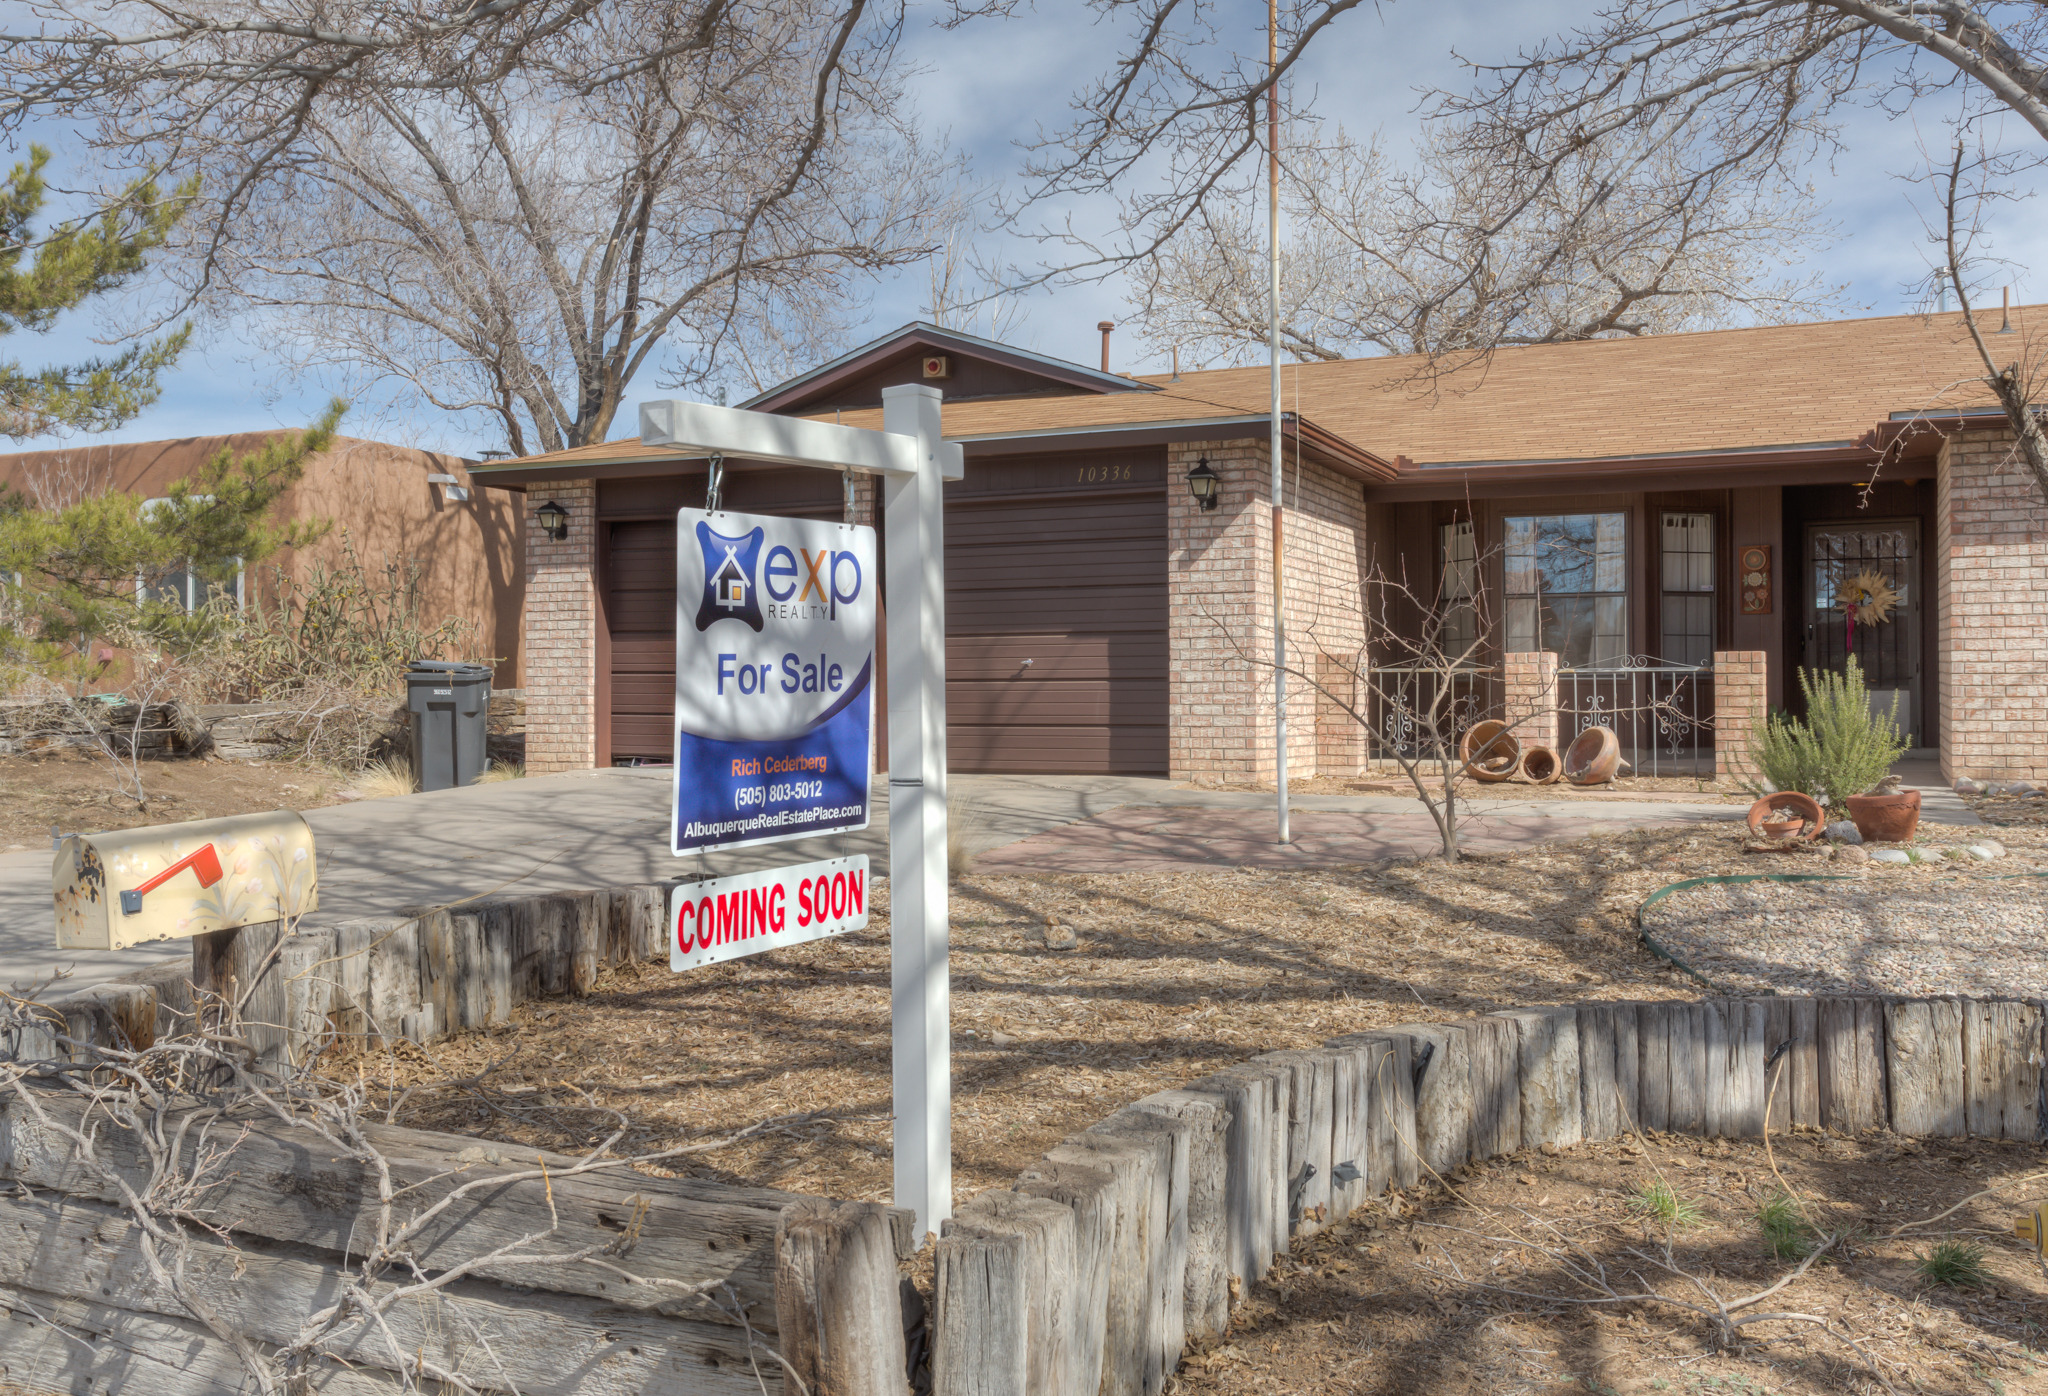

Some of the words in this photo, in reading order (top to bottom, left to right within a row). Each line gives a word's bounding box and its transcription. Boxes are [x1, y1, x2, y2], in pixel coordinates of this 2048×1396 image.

[1077, 465, 1131, 482] 10336
[764, 545, 862, 620] exp
[768, 604, 828, 619] REALTY
[717, 653, 772, 695] For
[781, 652, 843, 694] Sale
[731, 758, 761, 777] Rich
[764, 754, 827, 773] Cederberg
[735, 785, 766, 810] (505)
[769, 780, 822, 802] 803-5012
[684, 804, 862, 838] AlbuquerqueRealEstatePlace.com
[677, 883, 785, 954] COMING
[797, 868, 863, 928] SOON
